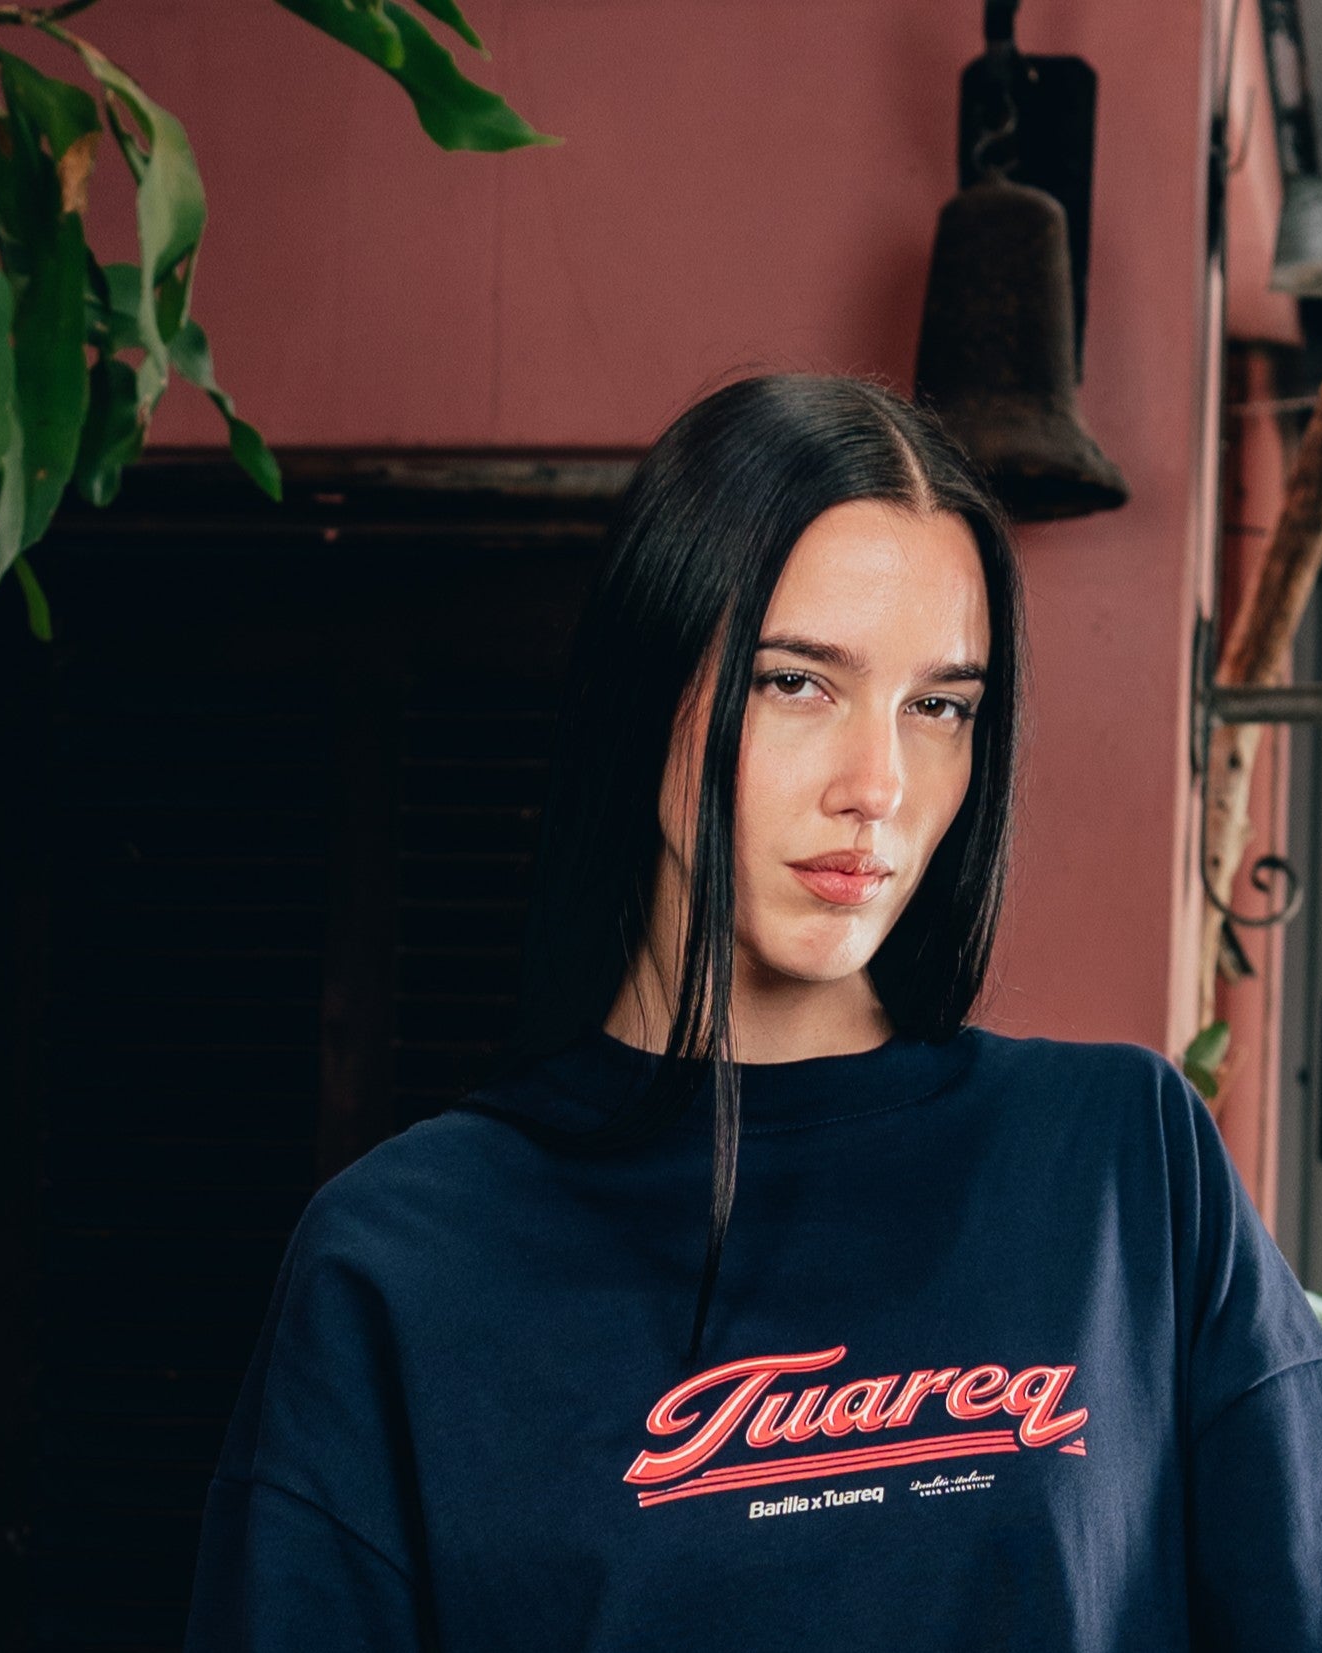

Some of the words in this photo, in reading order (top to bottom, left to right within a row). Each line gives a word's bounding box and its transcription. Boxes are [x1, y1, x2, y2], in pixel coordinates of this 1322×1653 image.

[623, 1345, 1089, 1483] Tuareq
[749, 1495, 809, 1519] Barilla
[811, 1496, 822, 1509] x
[823, 1486, 884, 1507] Tuareq
